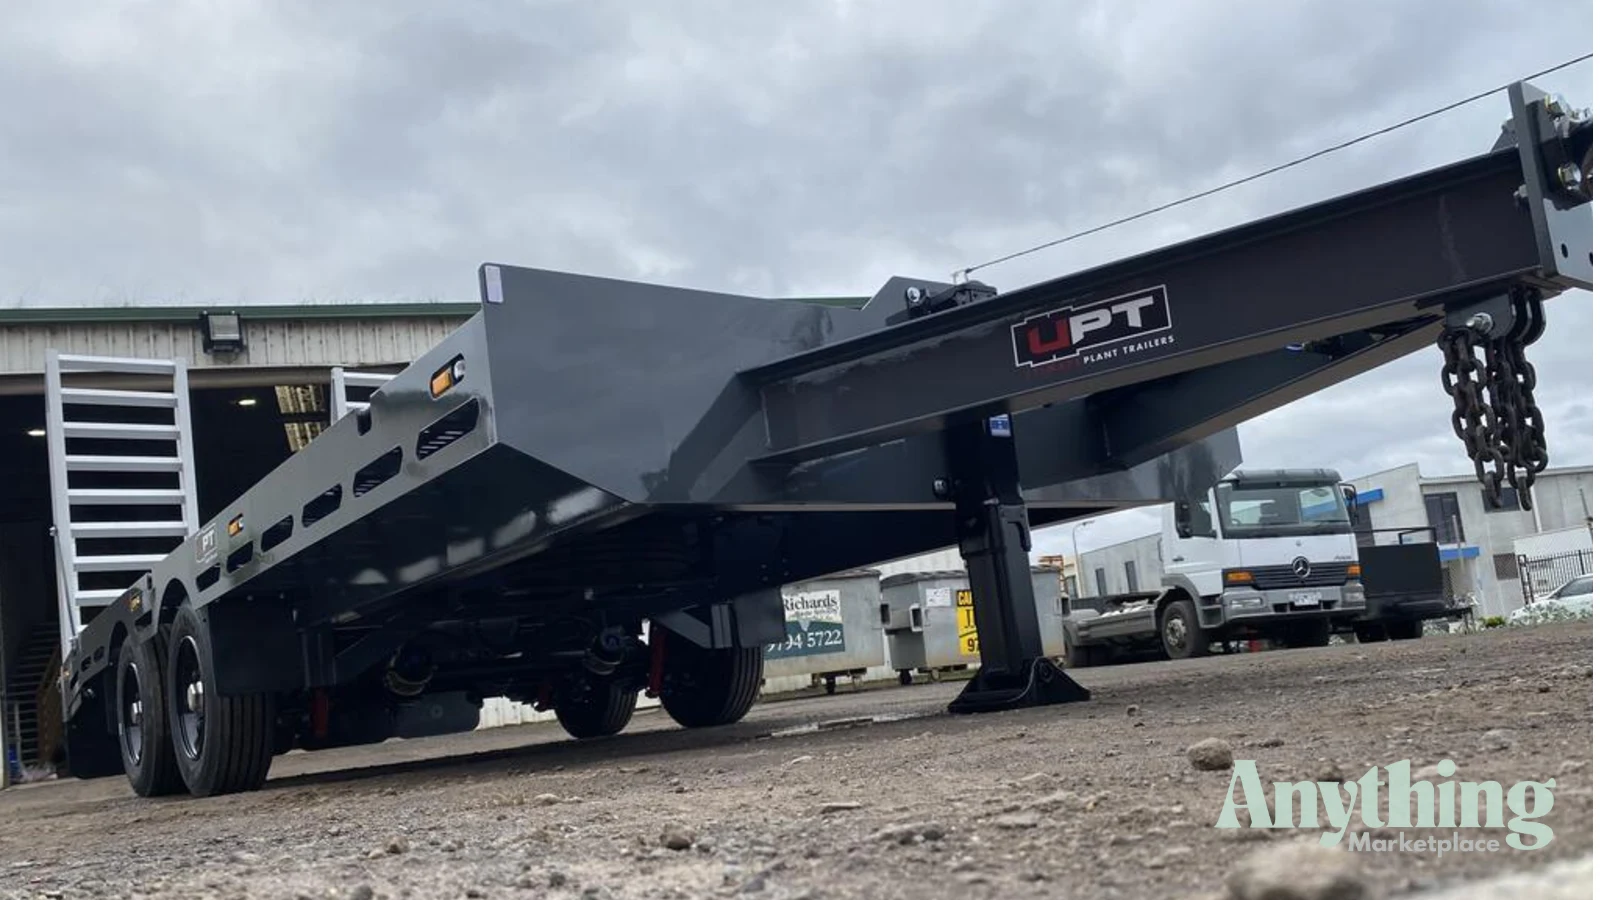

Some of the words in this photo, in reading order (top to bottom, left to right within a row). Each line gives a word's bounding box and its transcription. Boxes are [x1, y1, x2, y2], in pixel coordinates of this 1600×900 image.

[1027, 295, 1154, 355] UPT
[1083, 348, 1118, 365] PLANT
[1123, 335, 1175, 355] TRAILERS
[806, 629, 843, 648] 5722
